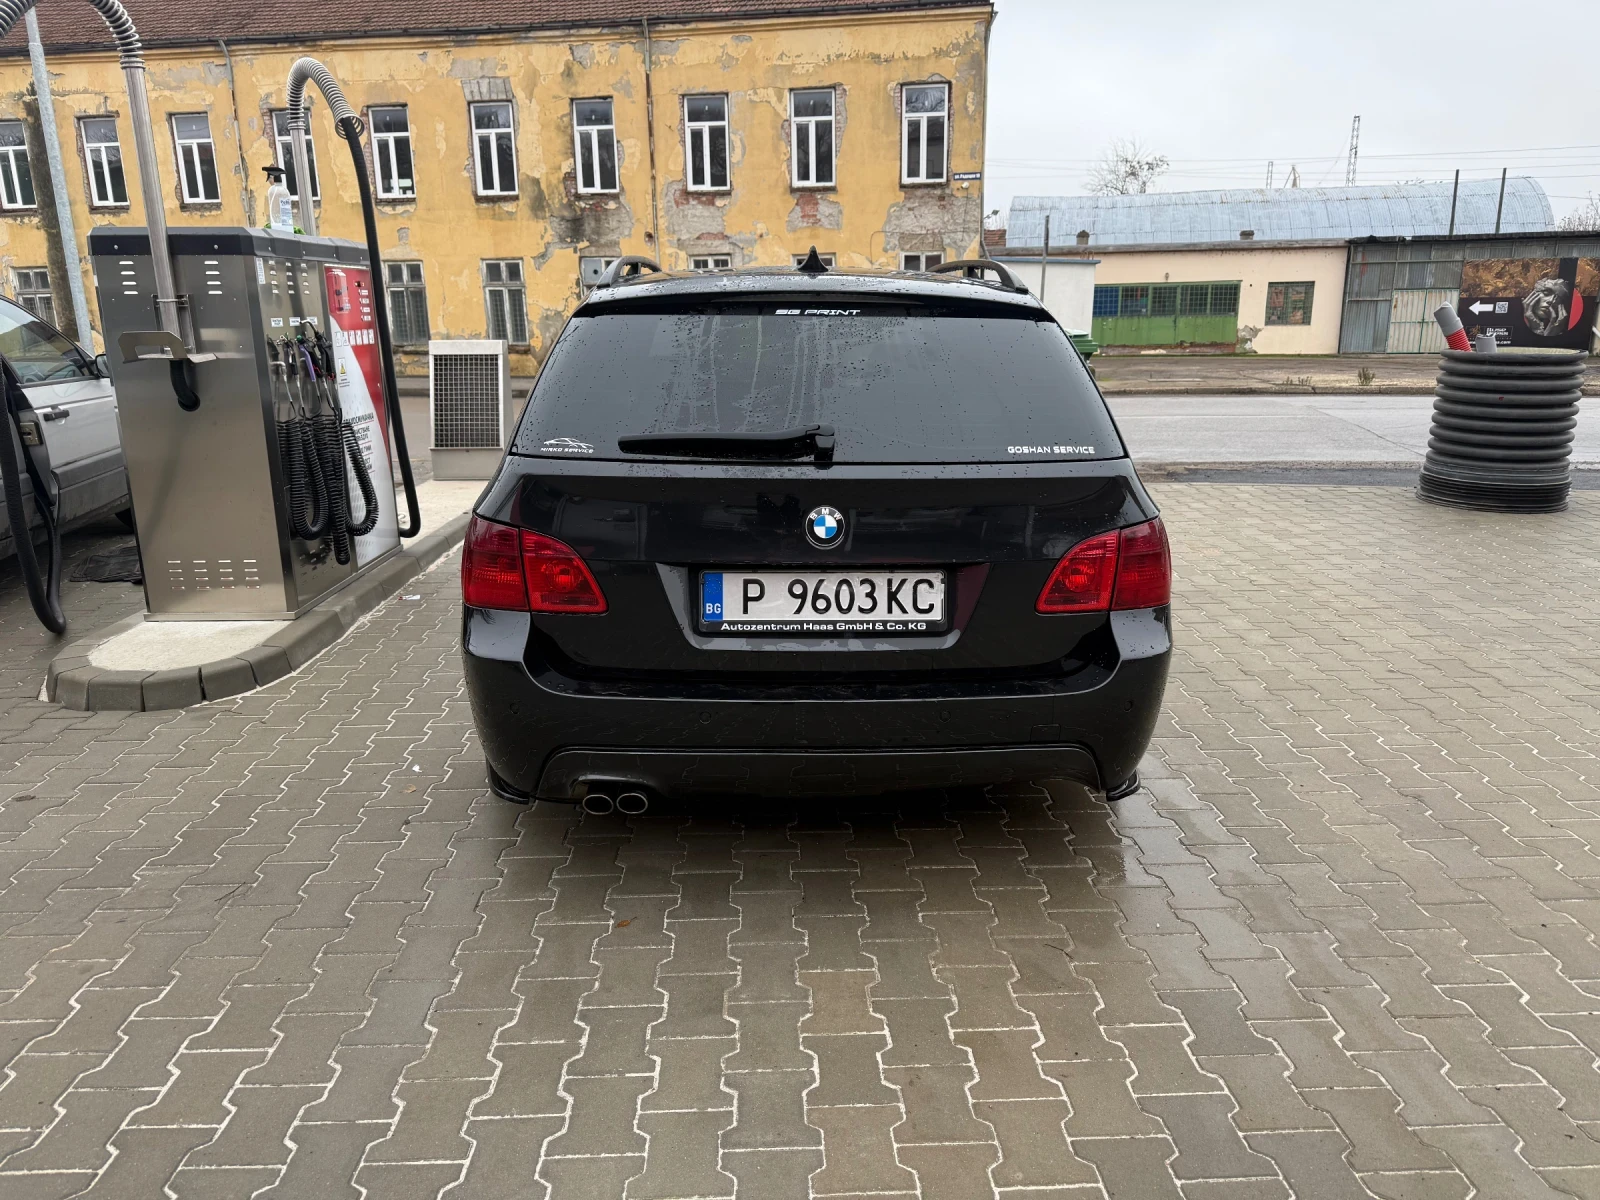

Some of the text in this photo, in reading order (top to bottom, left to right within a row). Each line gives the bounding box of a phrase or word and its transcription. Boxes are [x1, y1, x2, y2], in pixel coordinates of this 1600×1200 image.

[1007, 445, 1096, 454] GOSHAN SERVICE
[809, 508, 842, 521] BMW
[742, 578, 766, 615] P
[787, 578, 878, 615] 9603
[705, 603, 722, 614] BG
[720, 622, 927, 631] Autozentrum Haas GmbH & Co. KG
